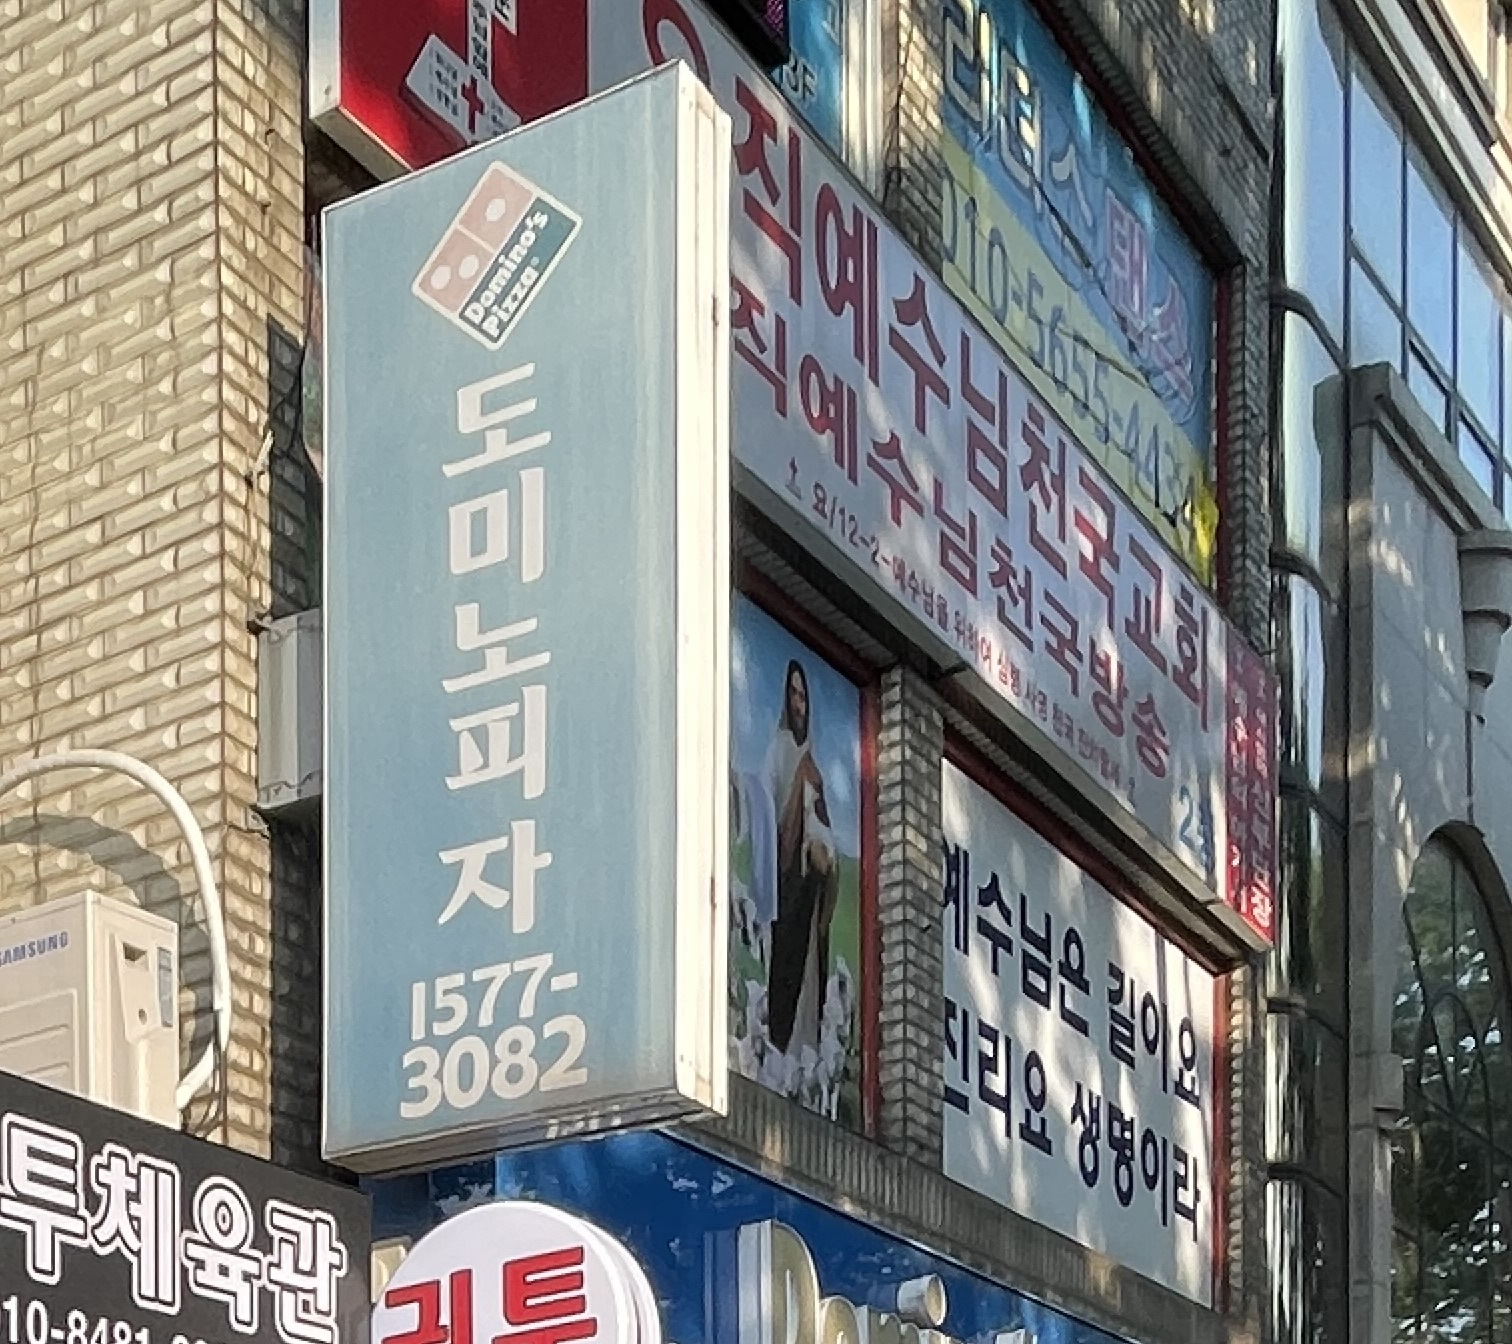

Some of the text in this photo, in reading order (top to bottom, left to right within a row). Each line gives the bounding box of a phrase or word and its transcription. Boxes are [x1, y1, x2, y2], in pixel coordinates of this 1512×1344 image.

[462, 208, 550, 326] Domino's
[480, 265, 541, 339] Pizza
[439, 361, 554, 934] 도미노피자
[410, 951, 579, 1041] 1577-
[1107, 961, 1201, 1112] 길이요
[398, 1013, 589, 1120] 3082
[1070, 1080, 1200, 1243] 생명이라
